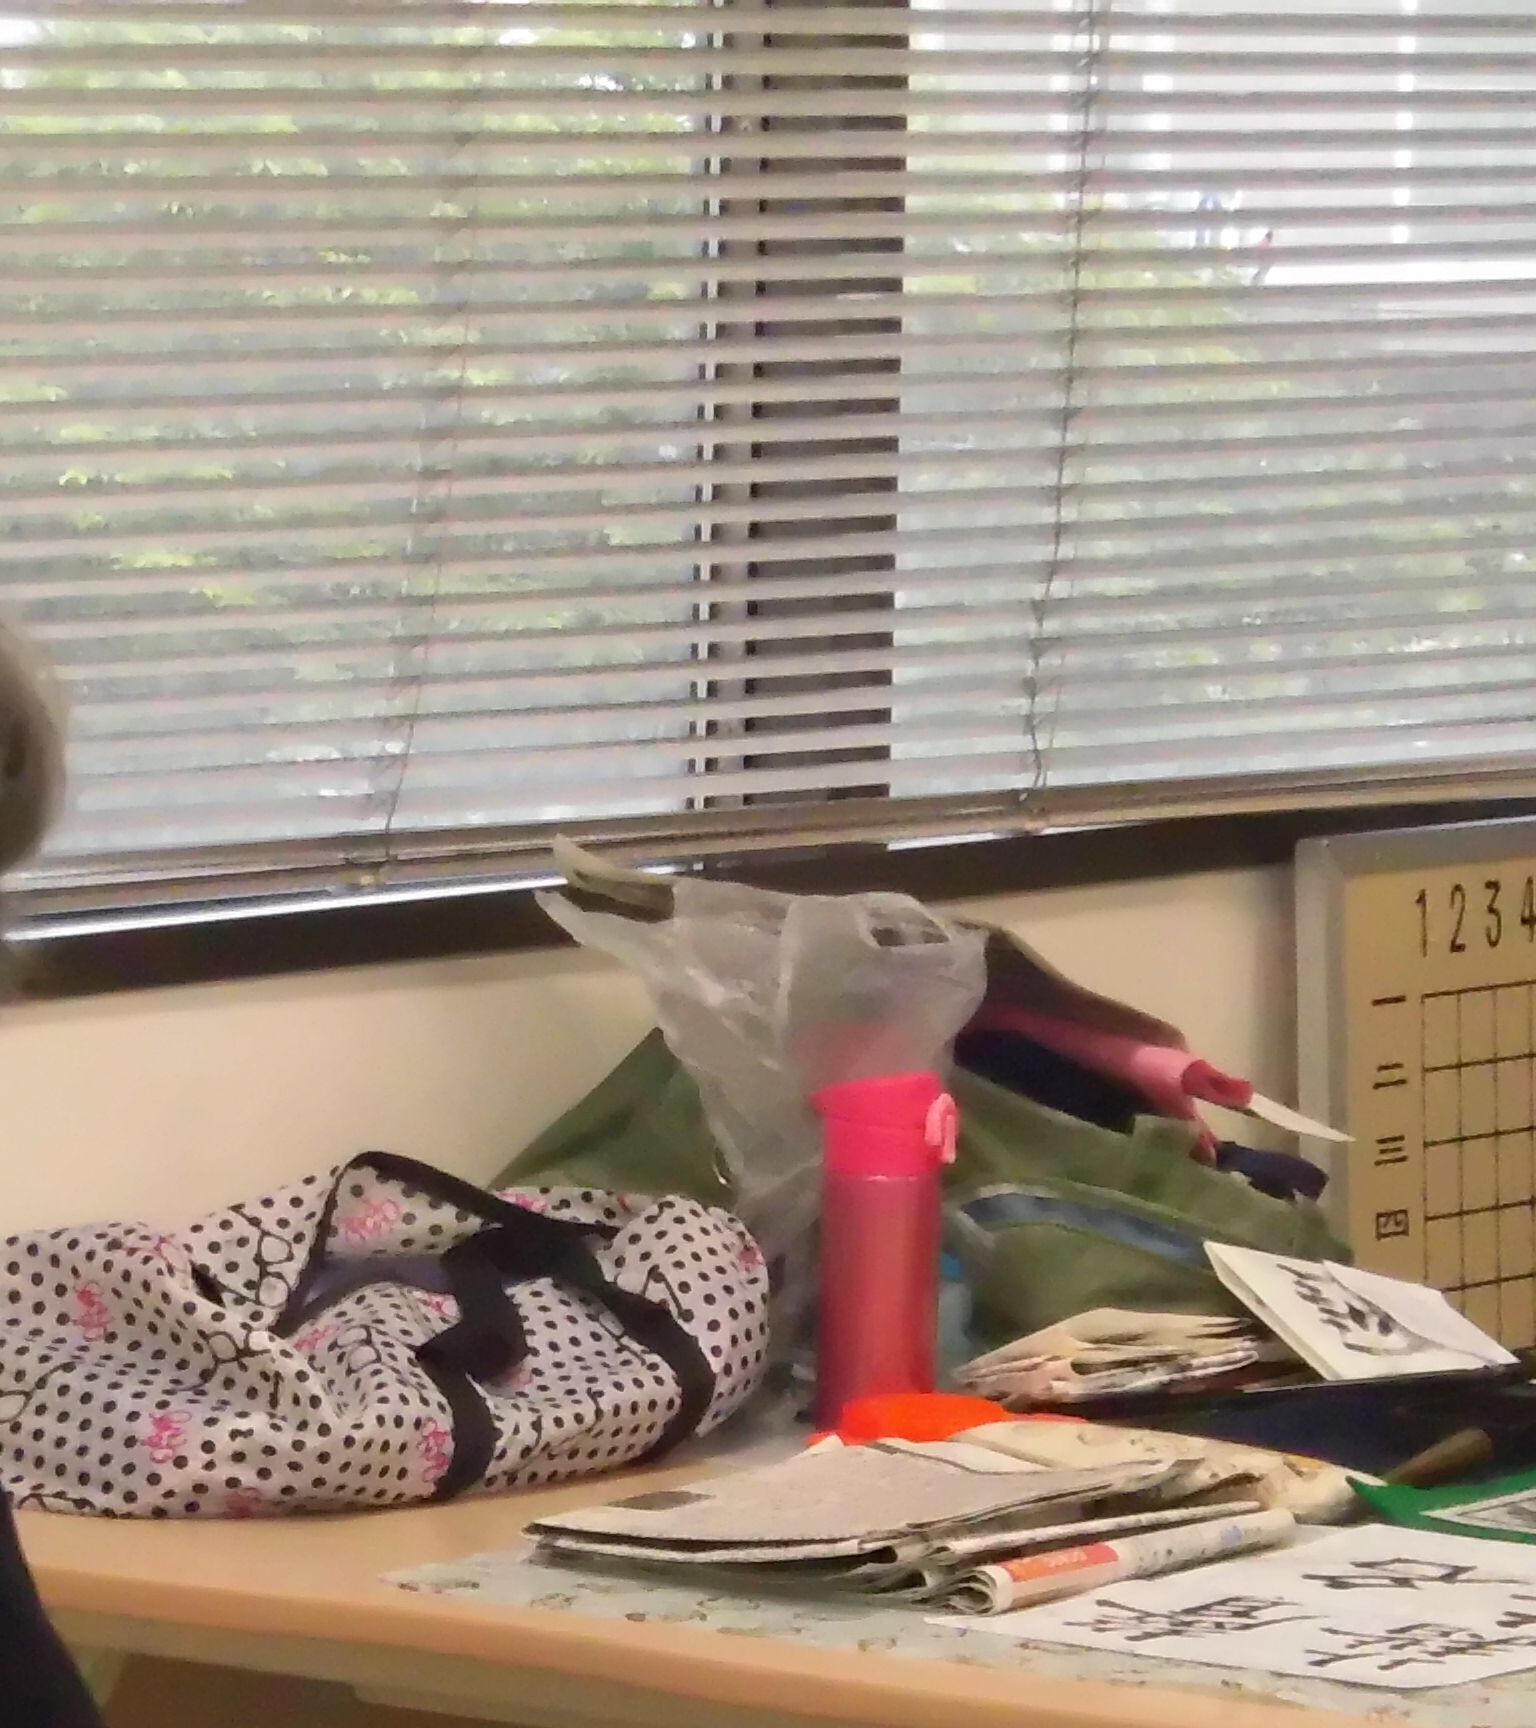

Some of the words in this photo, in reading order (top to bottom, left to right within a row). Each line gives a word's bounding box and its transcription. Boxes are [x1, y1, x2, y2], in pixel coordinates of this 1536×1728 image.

[1415, 888, 1429, 957] 1
[1449, 883, 1467, 955] 2
[1485, 880, 1503, 948] 3
[1371, 995, 1408, 1007] 一
[1372, 1062, 1408, 1091] 二
[1374, 1134, 1409, 1167] 三
[1374, 1209, 1410, 1240] 四
